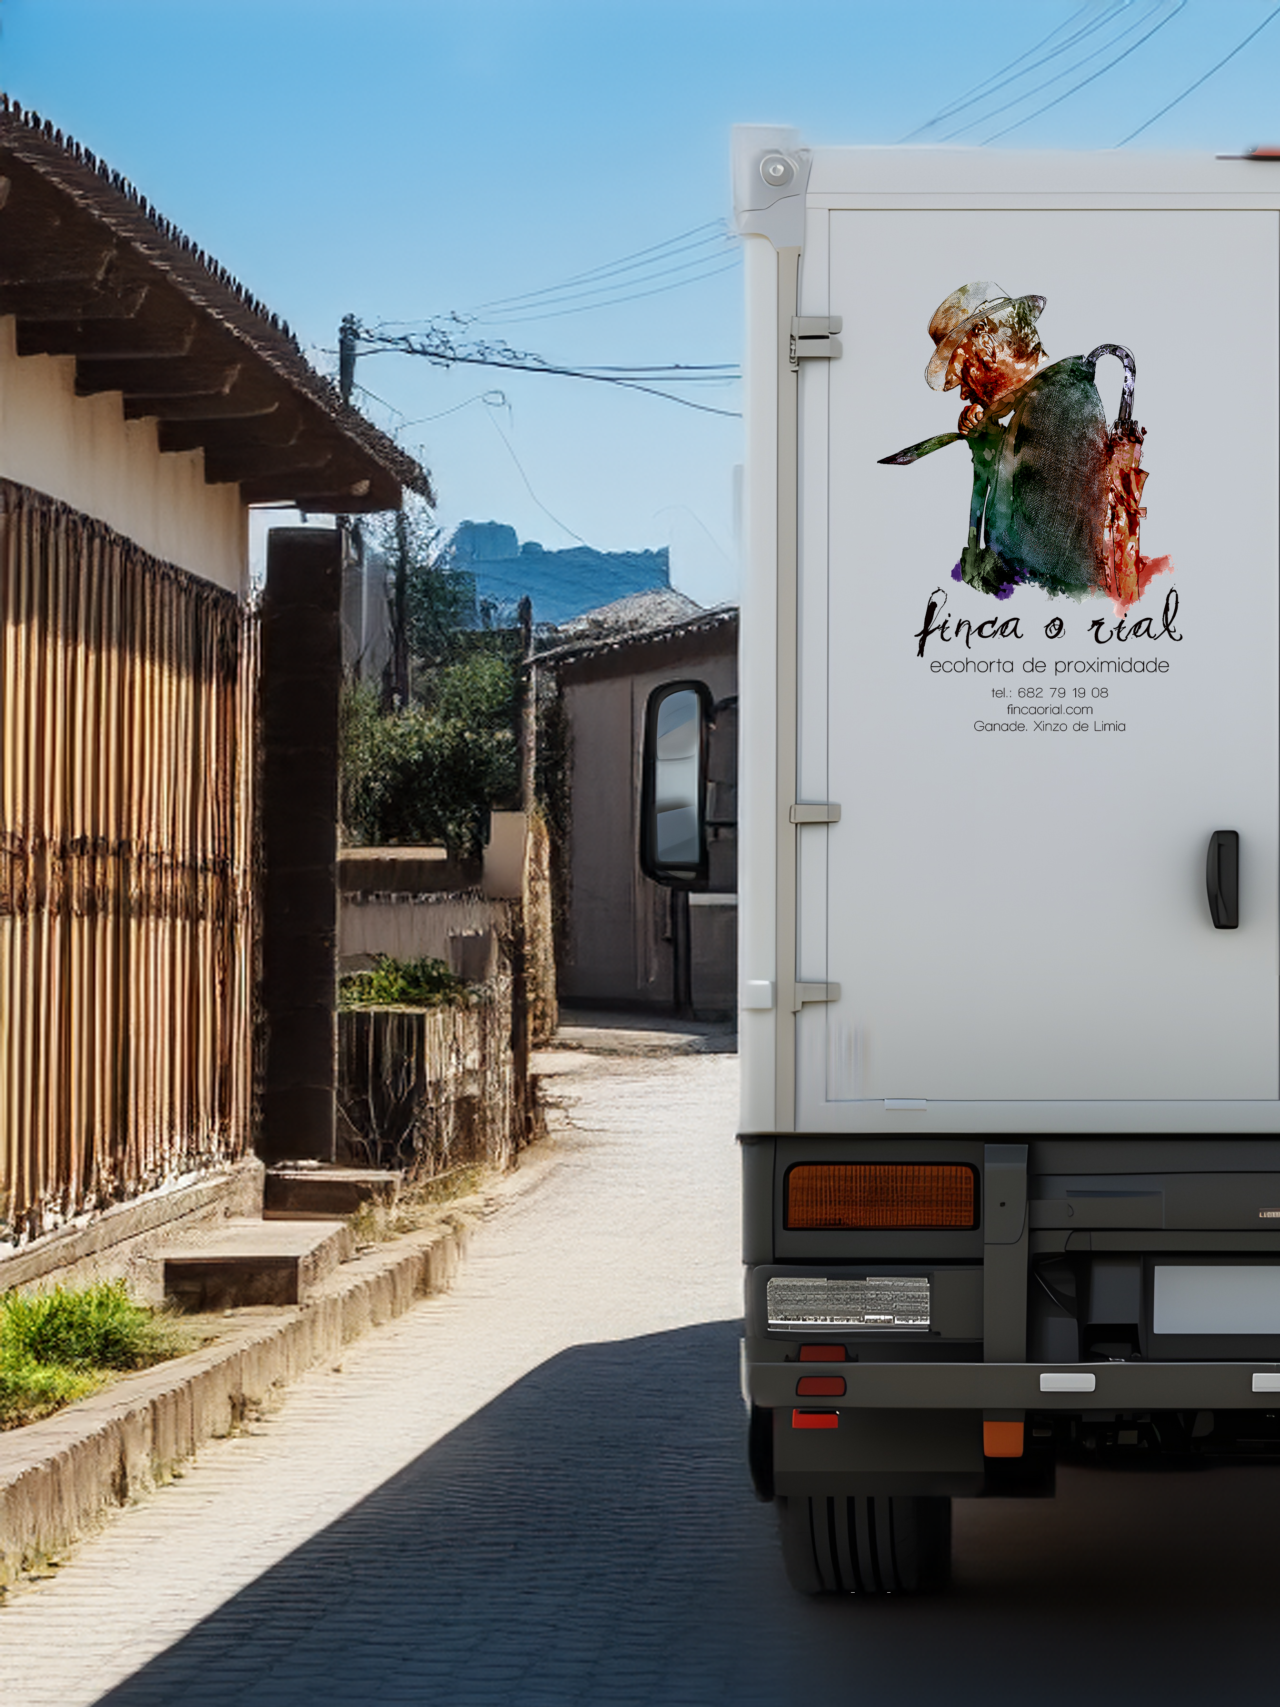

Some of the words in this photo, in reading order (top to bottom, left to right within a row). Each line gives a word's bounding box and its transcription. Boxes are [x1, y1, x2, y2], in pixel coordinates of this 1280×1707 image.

[914, 586, 1024, 658] finca
[1044, 616, 1066, 640] o
[1087, 585, 1184, 645] rial
[929, 656, 1014, 674] ecohorta
[1022, 656, 1047, 674] de
[1054, 656, 1170, 677] proximidade
[991, 687, 1012, 699] tel.:
[1017, 687, 1044, 699] 682
[1049, 687, 1067, 699] 79
[1072, 687, 1086, 699] 19
[1090, 687, 1109, 699] 08
[1006, 703, 1094, 716] fincaorial.com
[973, 720, 1028, 732] Ganade.
[1033, 720, 1068, 732] Xinzo
[1072, 720, 1090, 732] de
[1093, 720, 1127, 732] Limia
